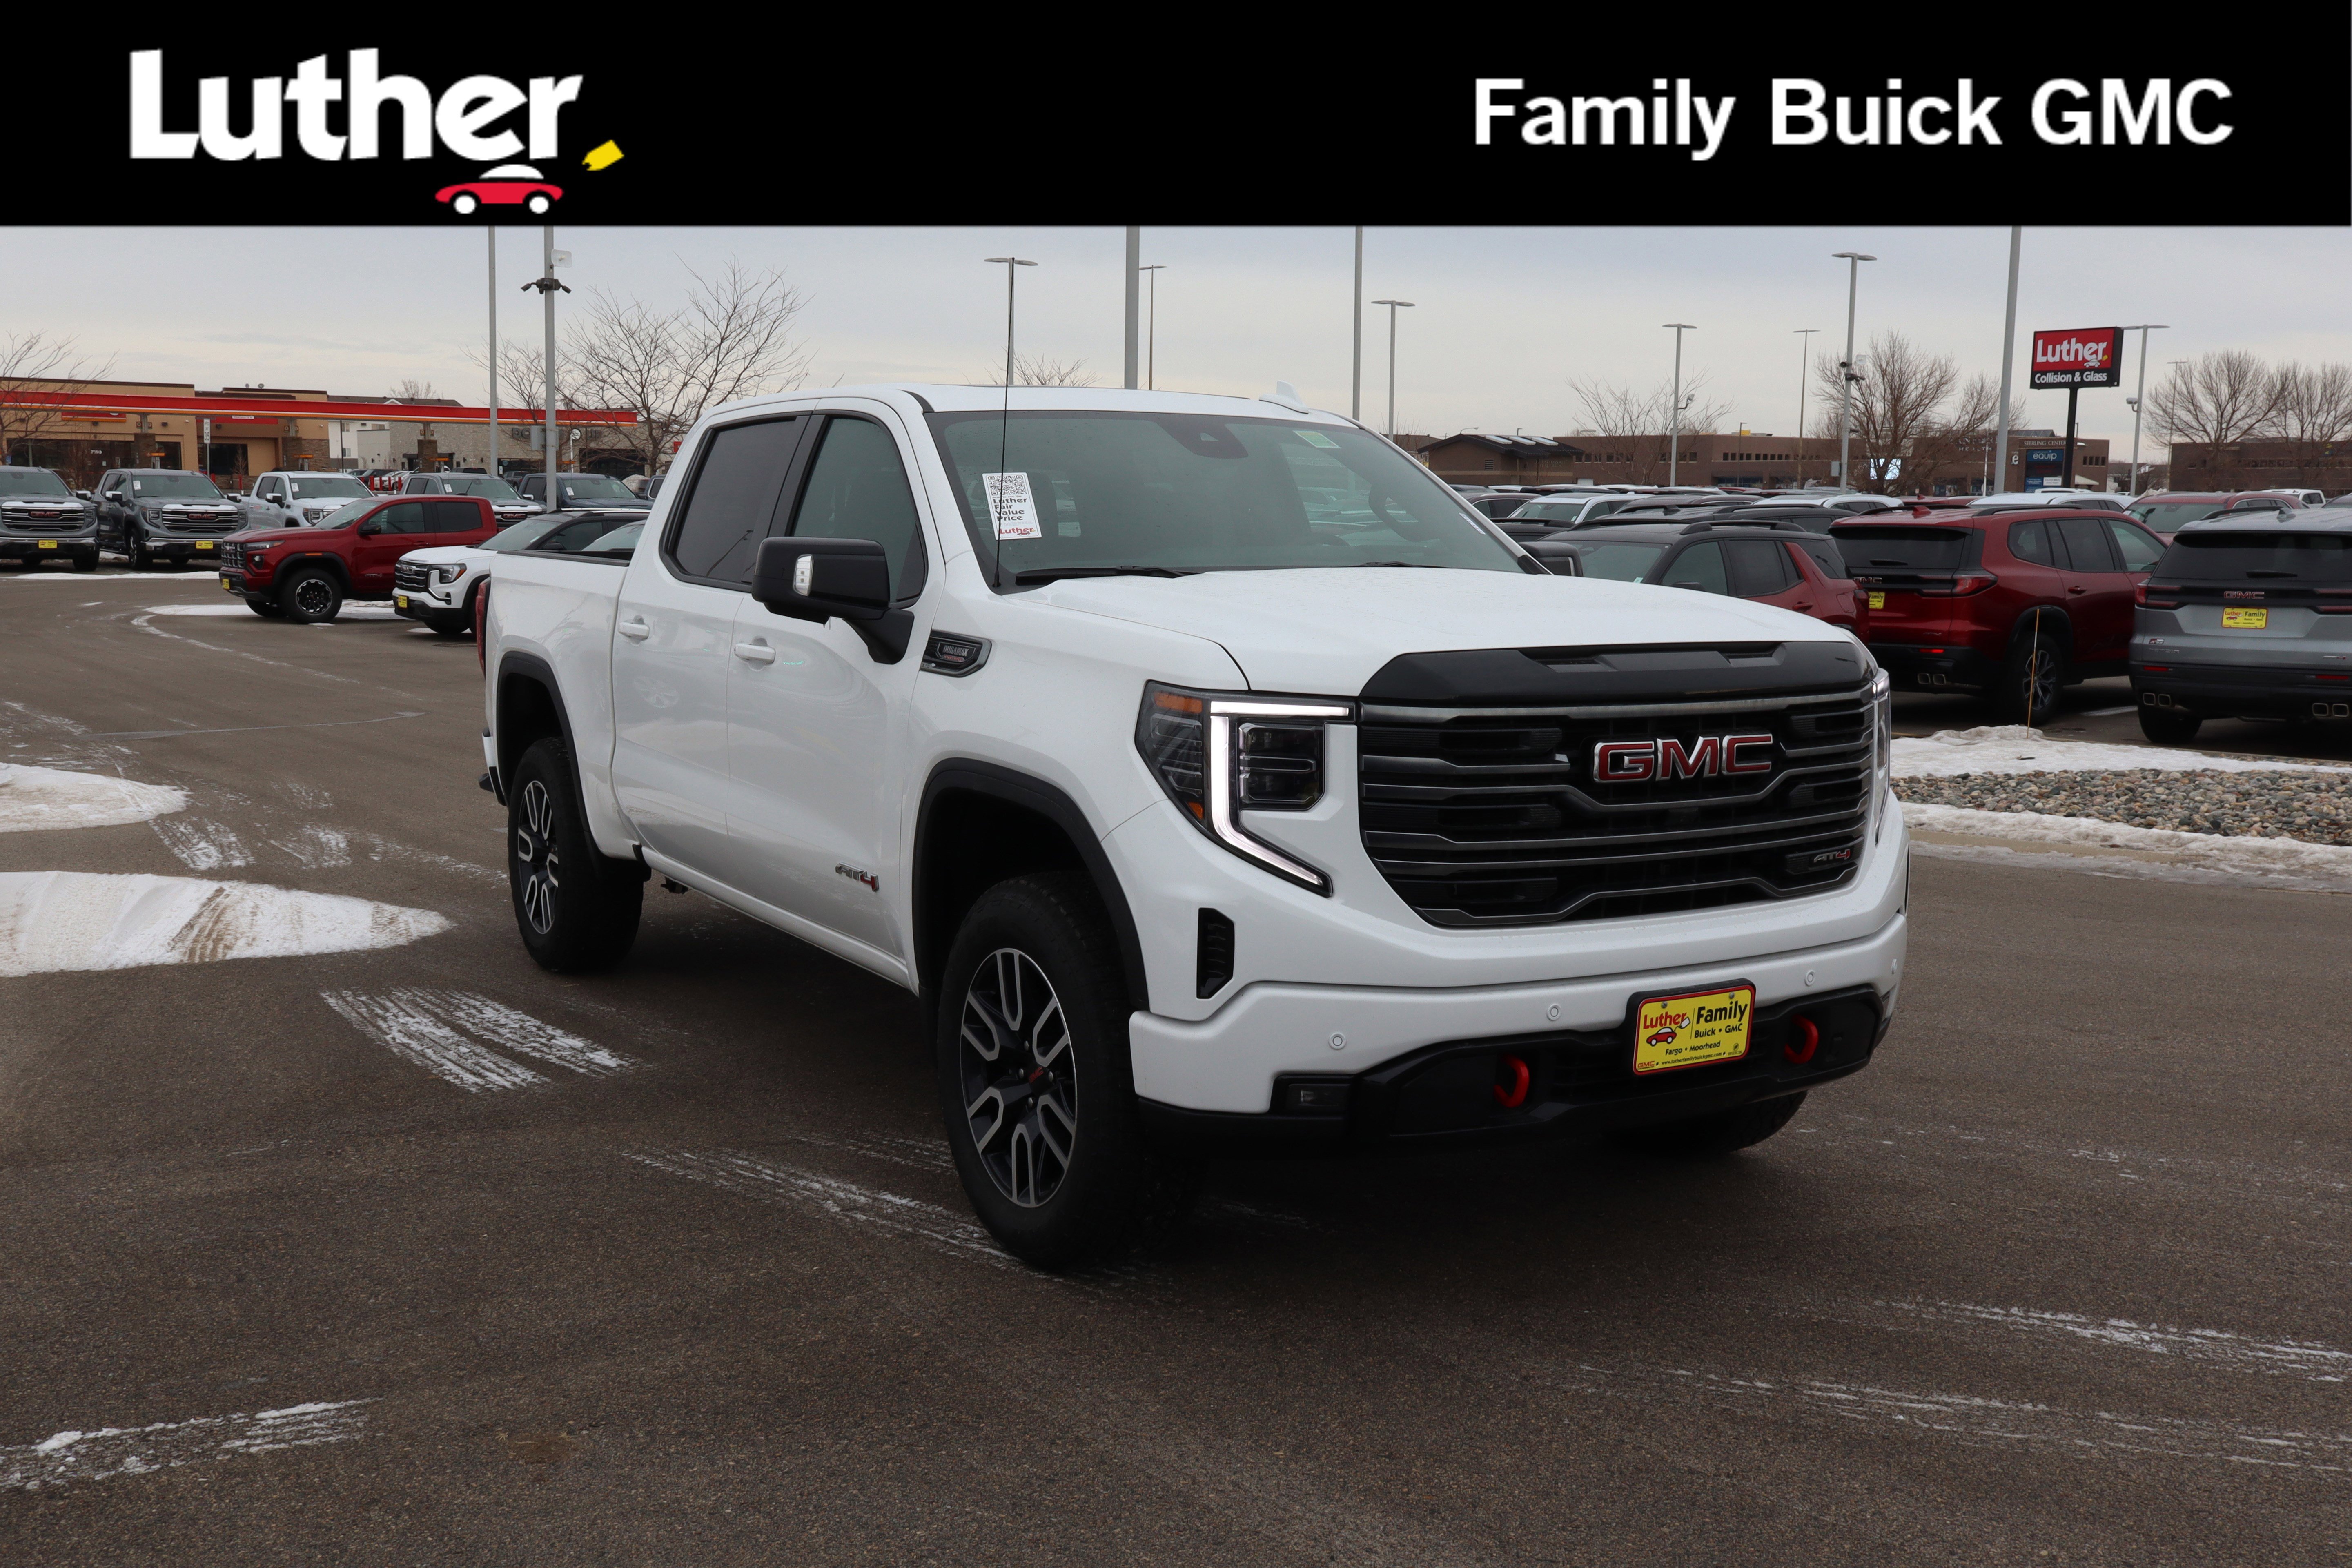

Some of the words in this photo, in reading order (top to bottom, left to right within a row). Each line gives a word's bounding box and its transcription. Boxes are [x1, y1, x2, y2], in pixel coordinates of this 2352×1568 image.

[2036, 337, 2107, 363] Luther
[2035, 372, 2071, 383] Collision
[2074, 371, 2081, 382] &
[2083, 371, 2107, 381] Glass
[2033, 451, 2057, 461] equip
[2224, 591, 2264, 599] GMC
[943, 645, 969, 657] DURAMAX
[1593, 734, 1773, 783] GMC
[1814, 849, 1850, 863] AT4
[835, 862, 879, 892] AT4
[1643, 1011, 1687, 1029] Luther
[1696, 1001, 1748, 1025] Family
[1694, 1027, 1716, 1038] Buick
[1725, 1023, 1743, 1034] GMC
[1689, 1041, 1721, 1052] Moorhead
